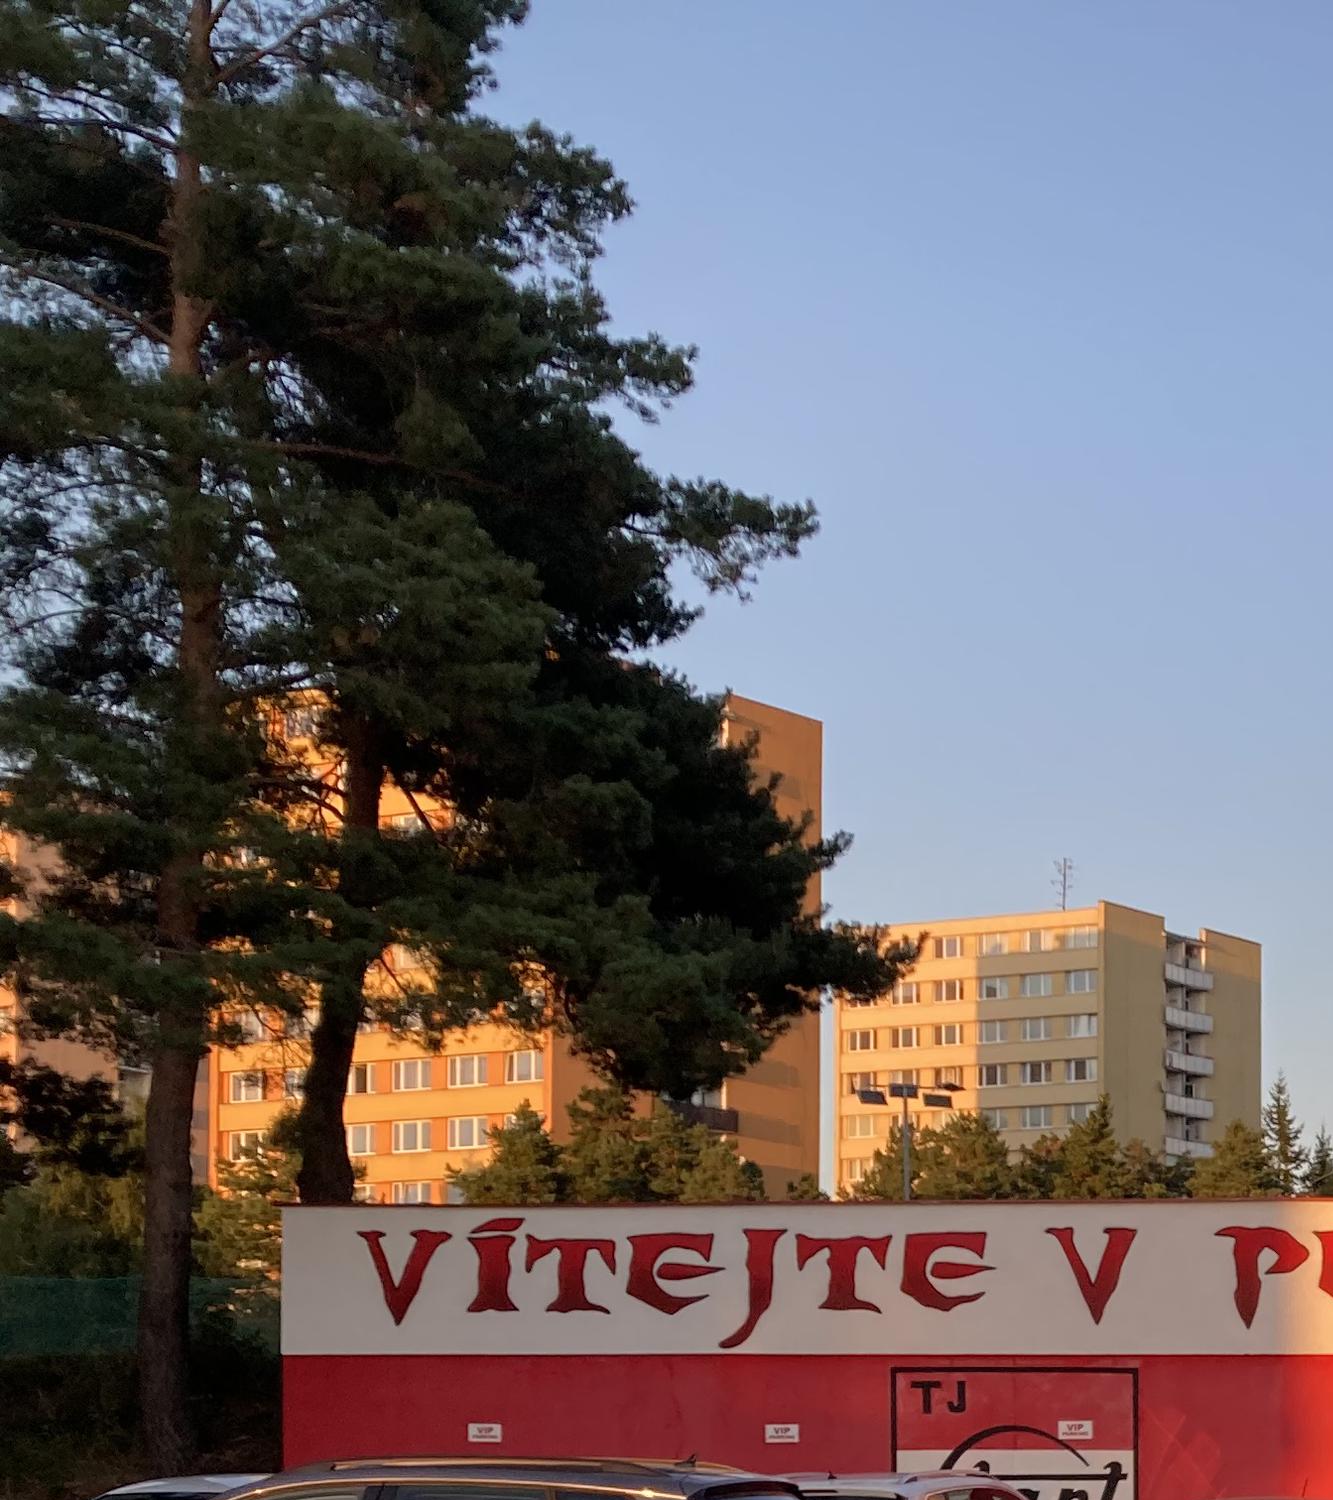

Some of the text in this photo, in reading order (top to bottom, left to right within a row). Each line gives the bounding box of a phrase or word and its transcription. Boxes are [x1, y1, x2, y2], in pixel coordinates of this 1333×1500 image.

[1046, 1227, 1137, 1325] V
[910, 1380, 967, 1414] TJ
[773, 1427, 791, 1435] VIP
[1066, 1423, 1085, 1431] VIP
